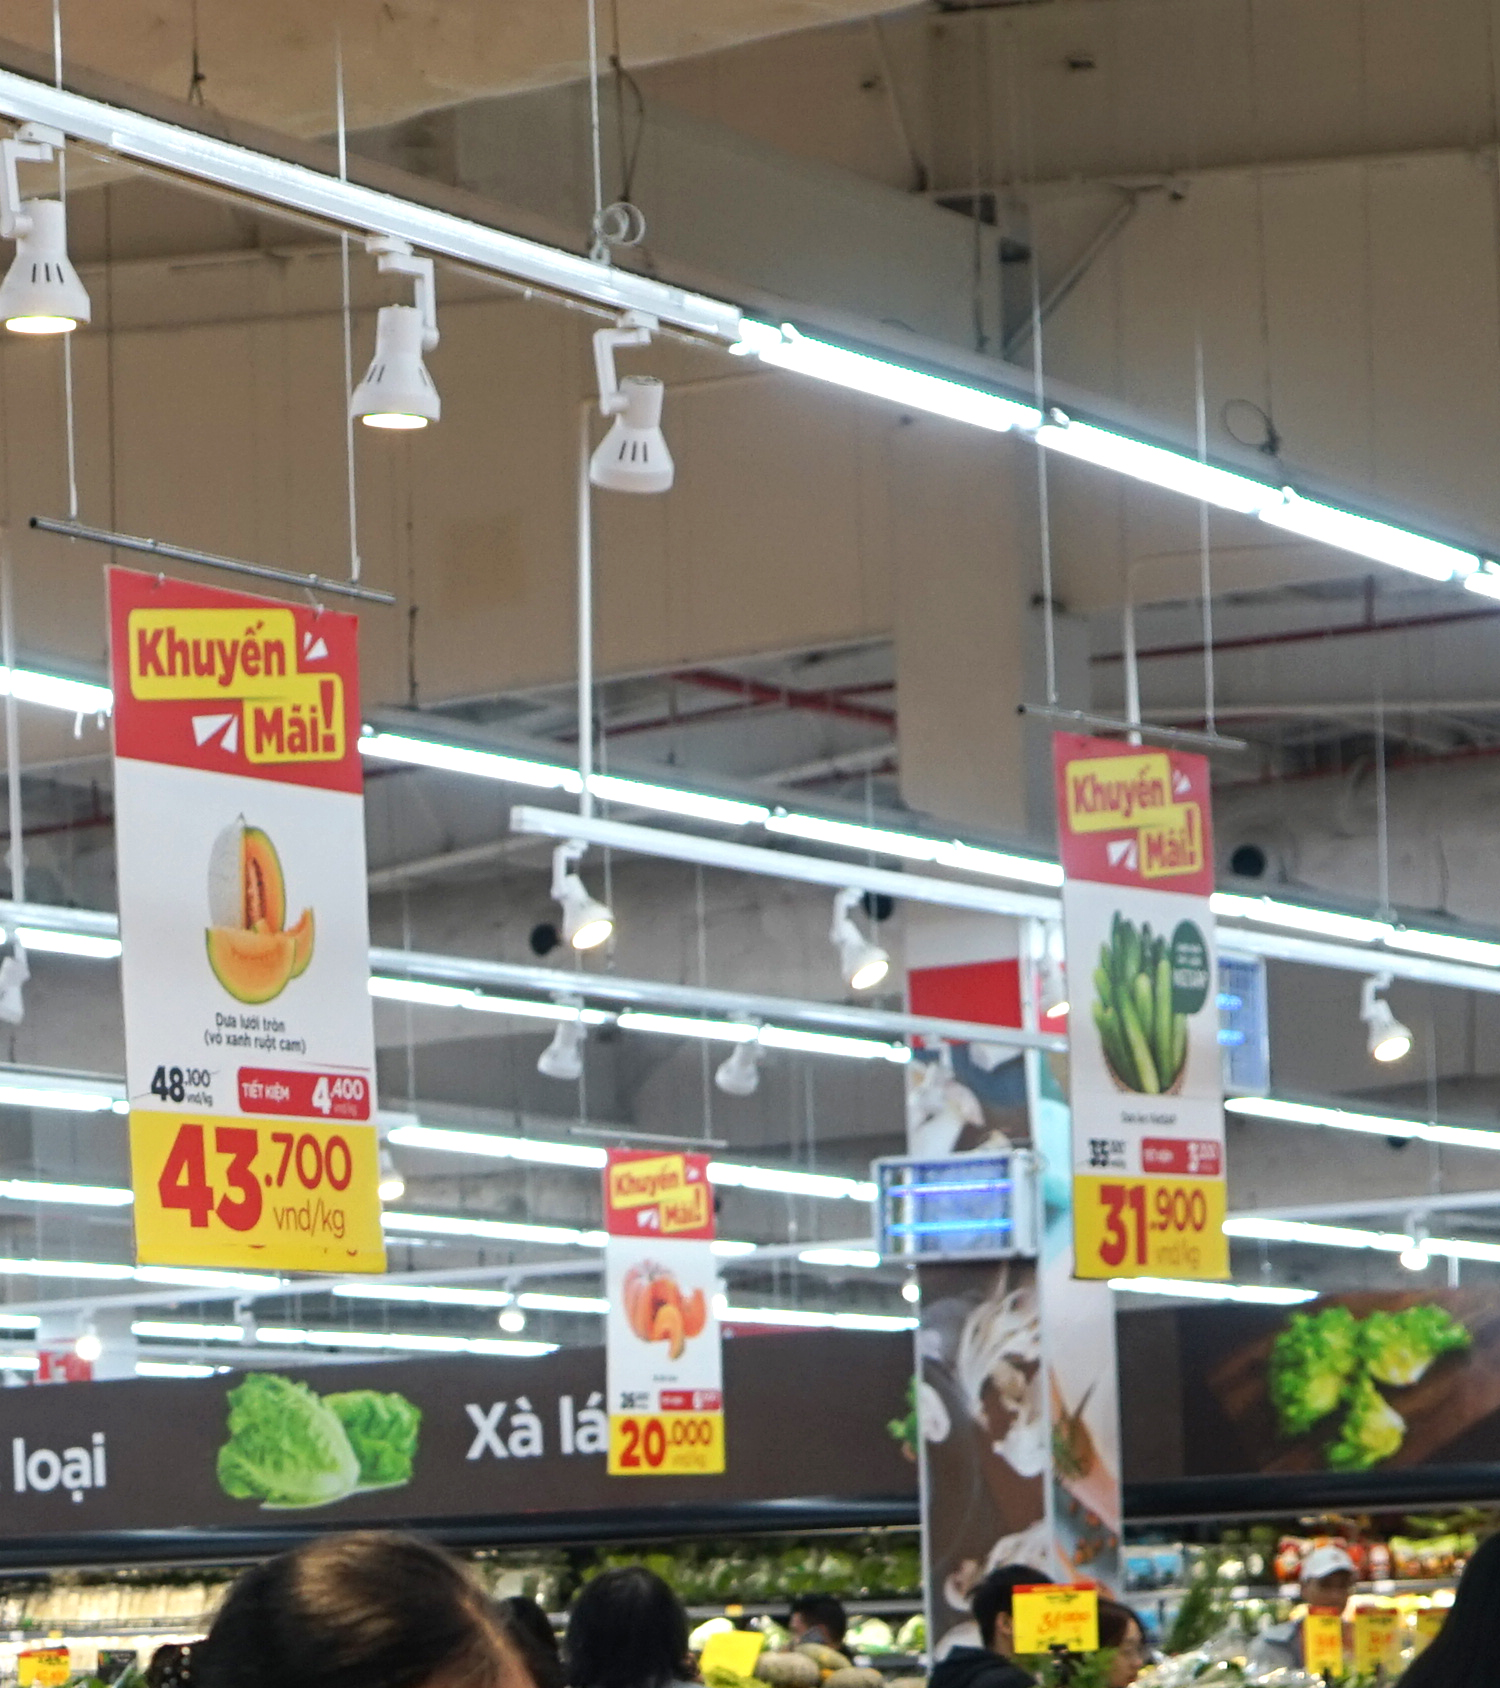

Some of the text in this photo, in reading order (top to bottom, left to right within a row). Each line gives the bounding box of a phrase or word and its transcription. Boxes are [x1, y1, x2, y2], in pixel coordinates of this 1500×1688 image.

[138, 620, 335, 754] Khuyến Mãi!
[242, 1079, 263, 1099] TIẾT
[265, 1081, 290, 1100] KIỆM
[312, 1077, 364, 1114] 4.400
[158, 1124, 352, 1231] 43.700
[273, 1197, 345, 1238] vnd/kg
[1099, 1184, 1207, 1266] 31.900
[465, 1391, 609, 1460] Xà lá
[619, 1420, 712, 1467] 20.000
[13, 1432, 106, 1503] loại
